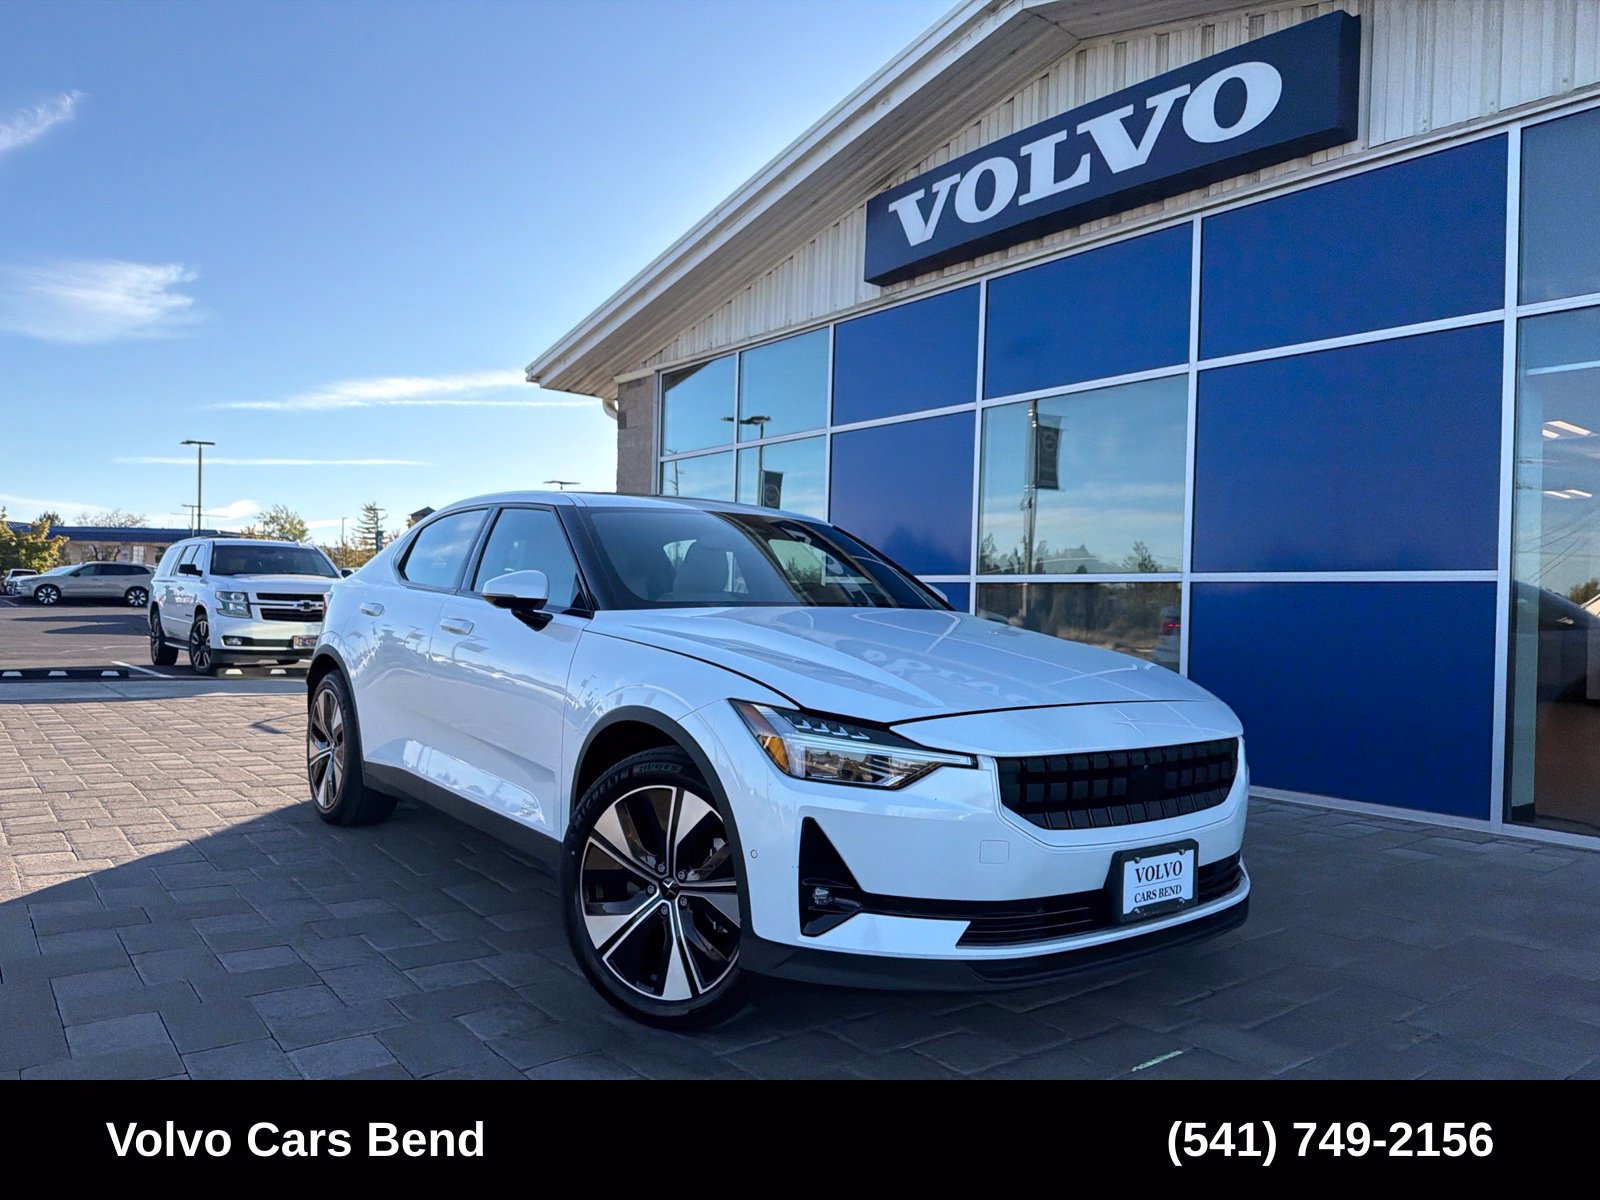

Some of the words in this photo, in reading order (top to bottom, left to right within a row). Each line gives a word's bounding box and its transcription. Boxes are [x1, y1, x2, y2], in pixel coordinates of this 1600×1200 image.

[888, 61, 1282, 247] VOLVO
[1135, 860, 1183, 884] VOLVO
[1134, 890, 1157, 904] CARS
[1158, 884, 1182, 899] BEND
